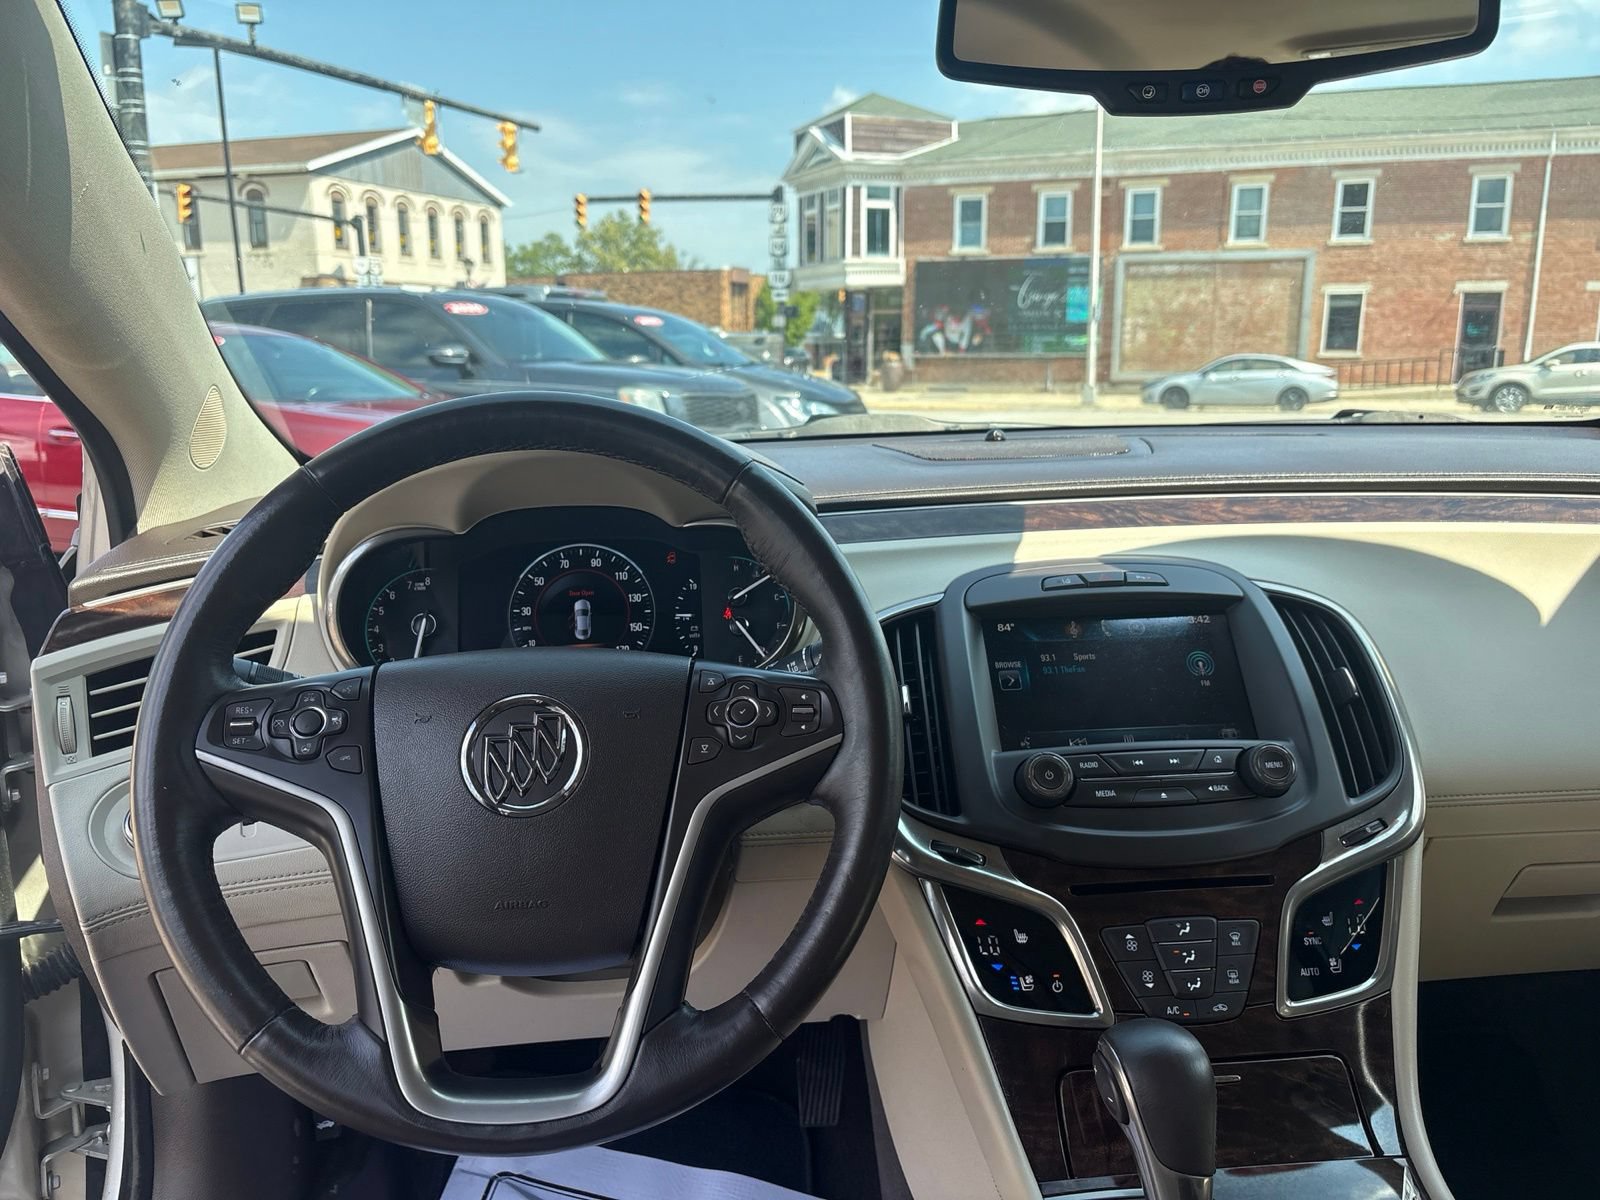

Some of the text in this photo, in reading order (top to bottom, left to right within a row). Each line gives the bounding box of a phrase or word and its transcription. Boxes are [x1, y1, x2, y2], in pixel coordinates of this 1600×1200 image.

[560, 559, 570, 569] 70
[591, 558, 601, 567] 90
[425, 577, 431, 586] 8
[534, 577, 544, 586] 50
[615, 572, 628, 581] 110
[407, 581, 413, 590] 7
[689, 583, 697, 591] 19
[389, 591, 396, 600] 6
[628, 593, 641, 602] 130
[774, 593, 779, 601] C
[378, 606, 385, 616] 5
[521, 606, 531, 616] 30
[1188, 615, 1211, 624] 3:42
[373, 625, 380, 633] 4
[629, 622, 643, 632] 150
[378, 643, 384, 653] 3
[1040, 652, 1096, 663] 93.1 Sports
[995, 660, 1022, 669] BROWSE
[1079, 760, 1099, 770] RADIO
[1264, 760, 1284, 770] MENU
[1212, 783, 1230, 793] BACK
[1095, 789, 1117, 799] MEDIA
[493, 900, 550, 910] AIRBAG
[1303, 936, 1322, 946] SYNC
[1300, 967, 1320, 977] AUTO
[1166, 1005, 1180, 1015] A/C
